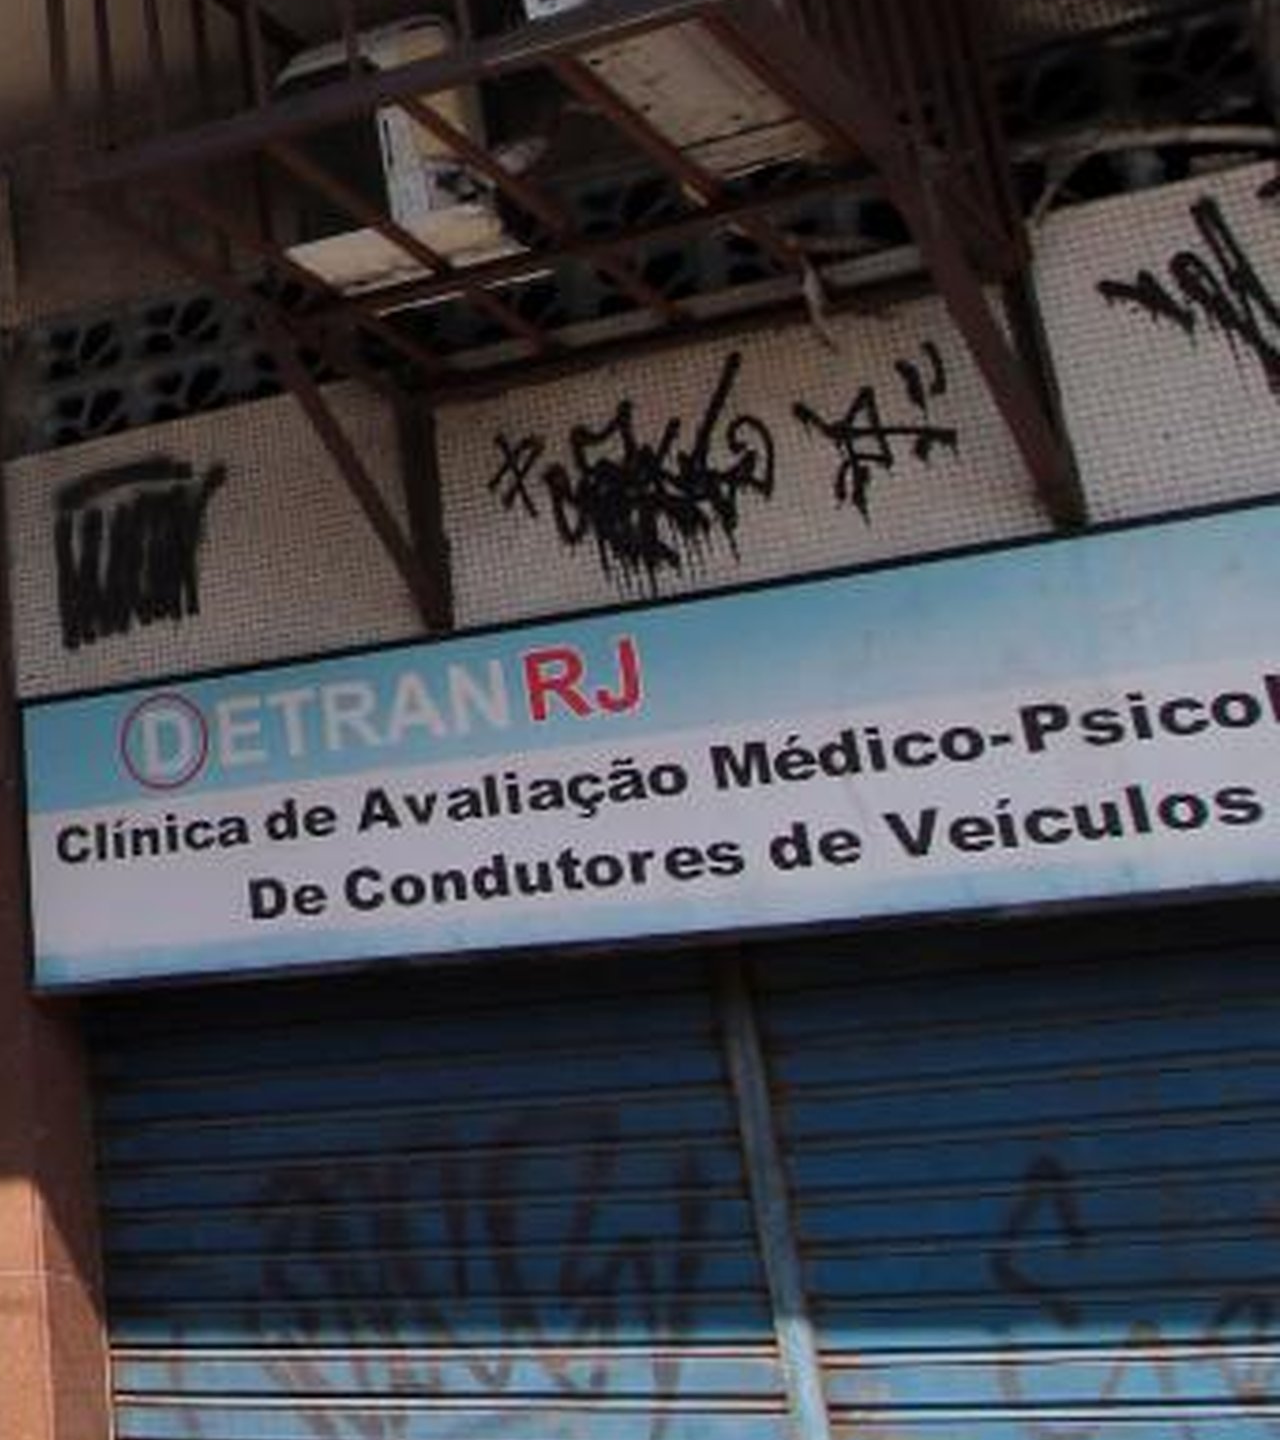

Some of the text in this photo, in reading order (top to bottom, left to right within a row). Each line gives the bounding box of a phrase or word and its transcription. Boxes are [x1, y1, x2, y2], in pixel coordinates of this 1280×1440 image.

[140, 660, 509, 779] DETRAN
[56, 810, 249, 865] Clínica
[264, 799, 336, 841] de
[359, 755, 688, 832] Avaliação
[248, 785, 1264, 921] De Condutores de Veículos
